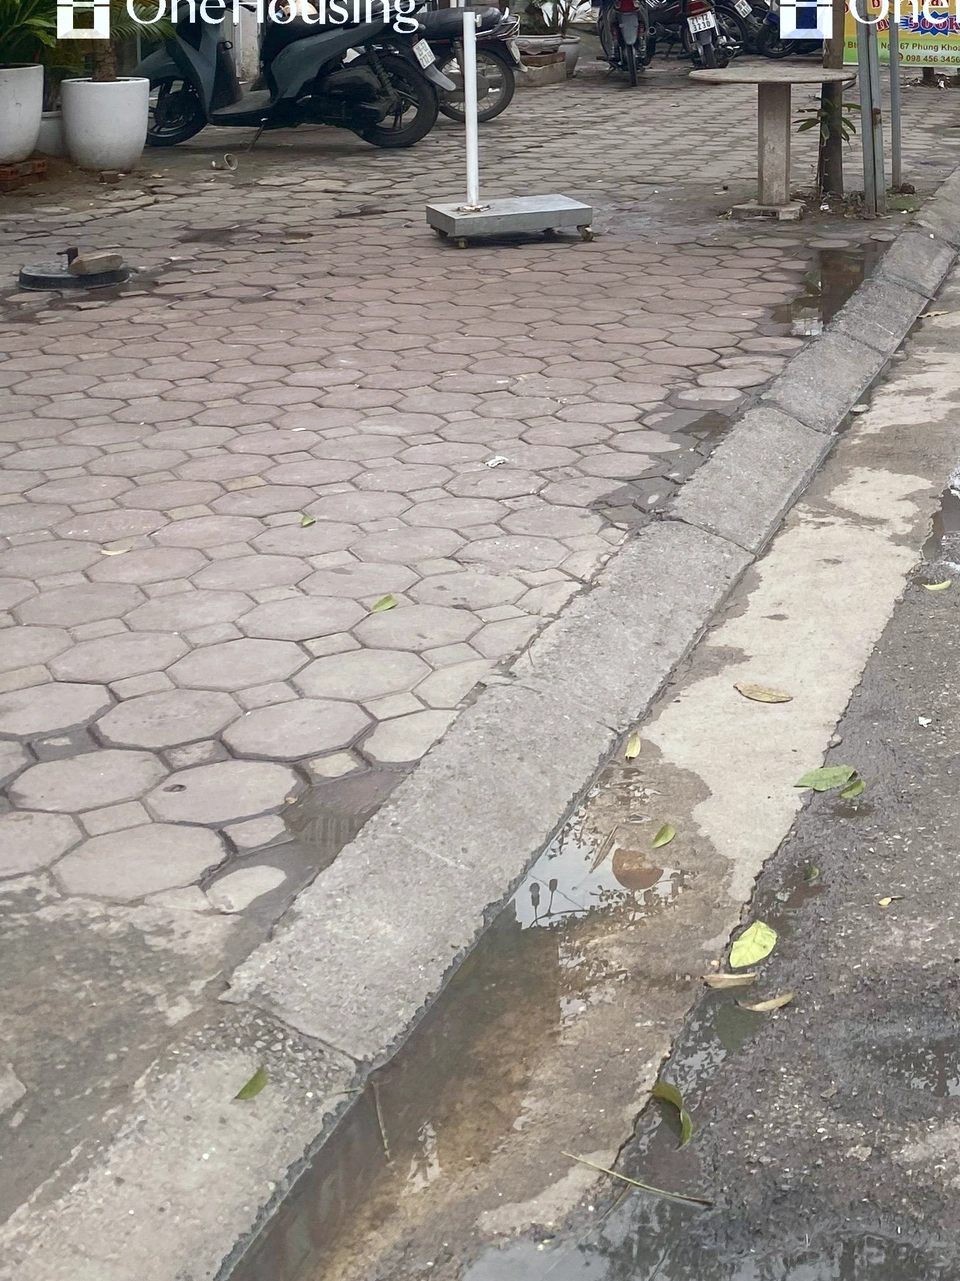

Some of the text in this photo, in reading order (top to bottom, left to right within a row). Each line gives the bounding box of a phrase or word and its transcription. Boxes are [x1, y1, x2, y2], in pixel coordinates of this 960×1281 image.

[905, 54, 960, 64] 098 456 3456
